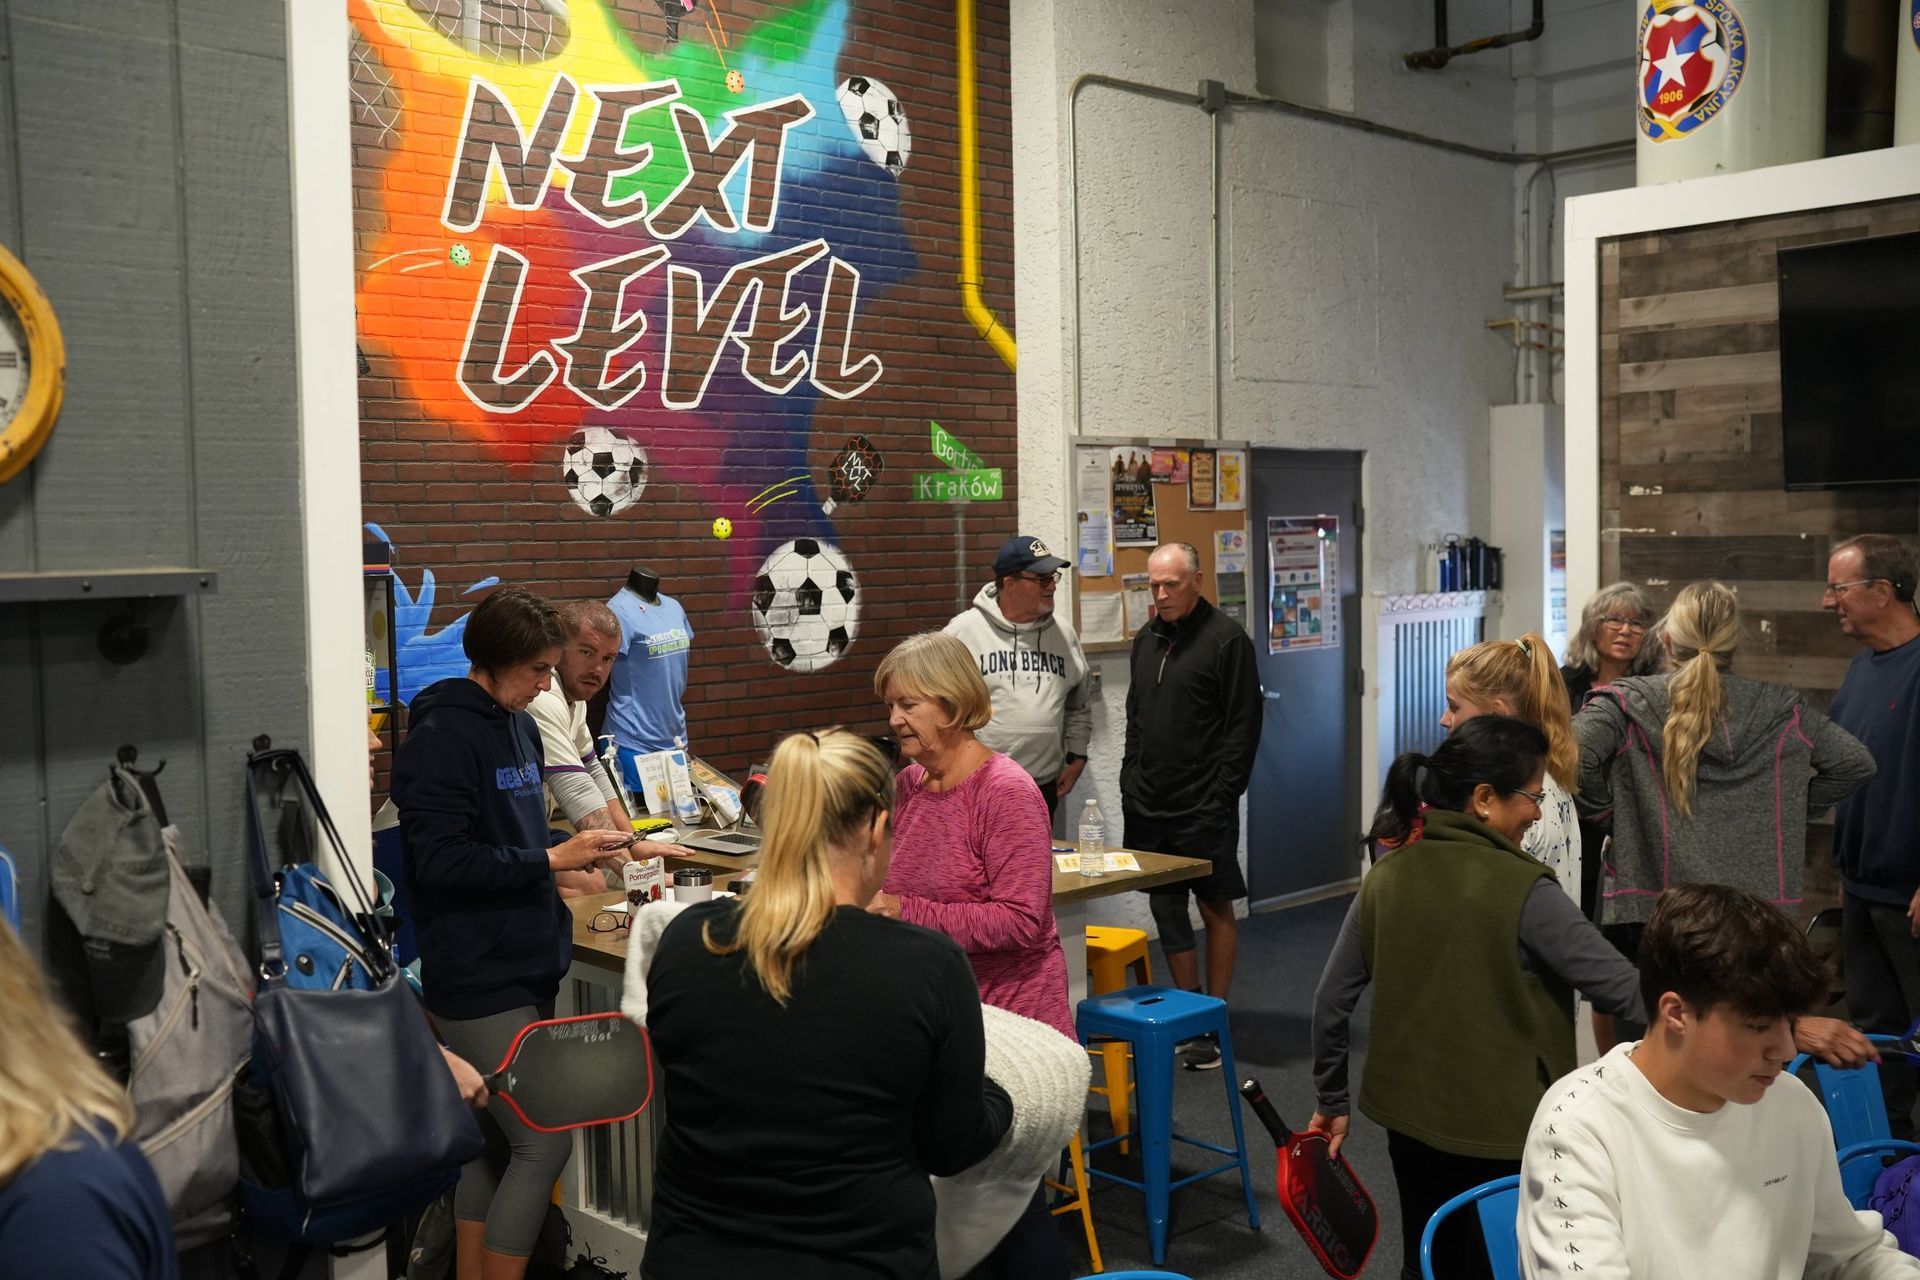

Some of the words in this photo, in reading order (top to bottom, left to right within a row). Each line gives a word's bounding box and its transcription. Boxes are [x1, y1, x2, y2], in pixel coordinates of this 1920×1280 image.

[1659, 89, 1684, 105] 1906
[1693, 57, 1744, 121] AKCYJNA
[440, 72, 817, 241] NEXT
[455, 238, 883, 413] LEVEL
[919, 474, 998, 499] Kraków
[980, 650, 1018, 677] LONG
[1021, 650, 1066, 679] BEACH
